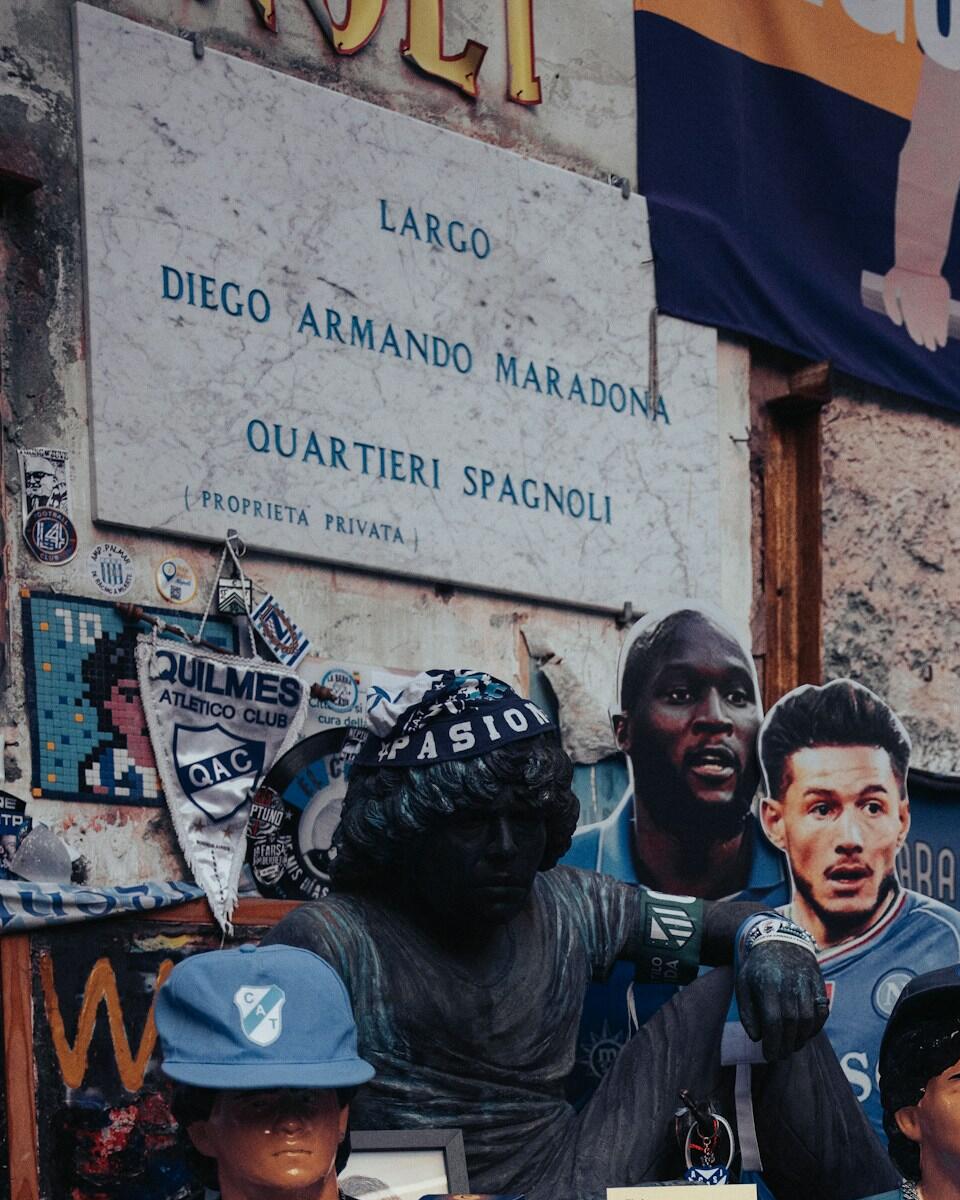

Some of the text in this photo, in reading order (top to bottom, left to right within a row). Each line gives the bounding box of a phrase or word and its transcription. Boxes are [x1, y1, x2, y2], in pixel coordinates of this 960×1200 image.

[379, 198, 491, 260] LARGO
[160, 264, 671, 425] DIEGO ARMANDO MARADONA
[246, 419, 612, 525] QUARTIERI SPAGNOLI
[155, 650, 300, 708] QUILMES
[160, 691, 288, 728] ATLETICO CLUB
[318, 714, 341, 725] cura
[189, 747, 253, 786] QAC
[250, 804, 283, 826] PTUNO
